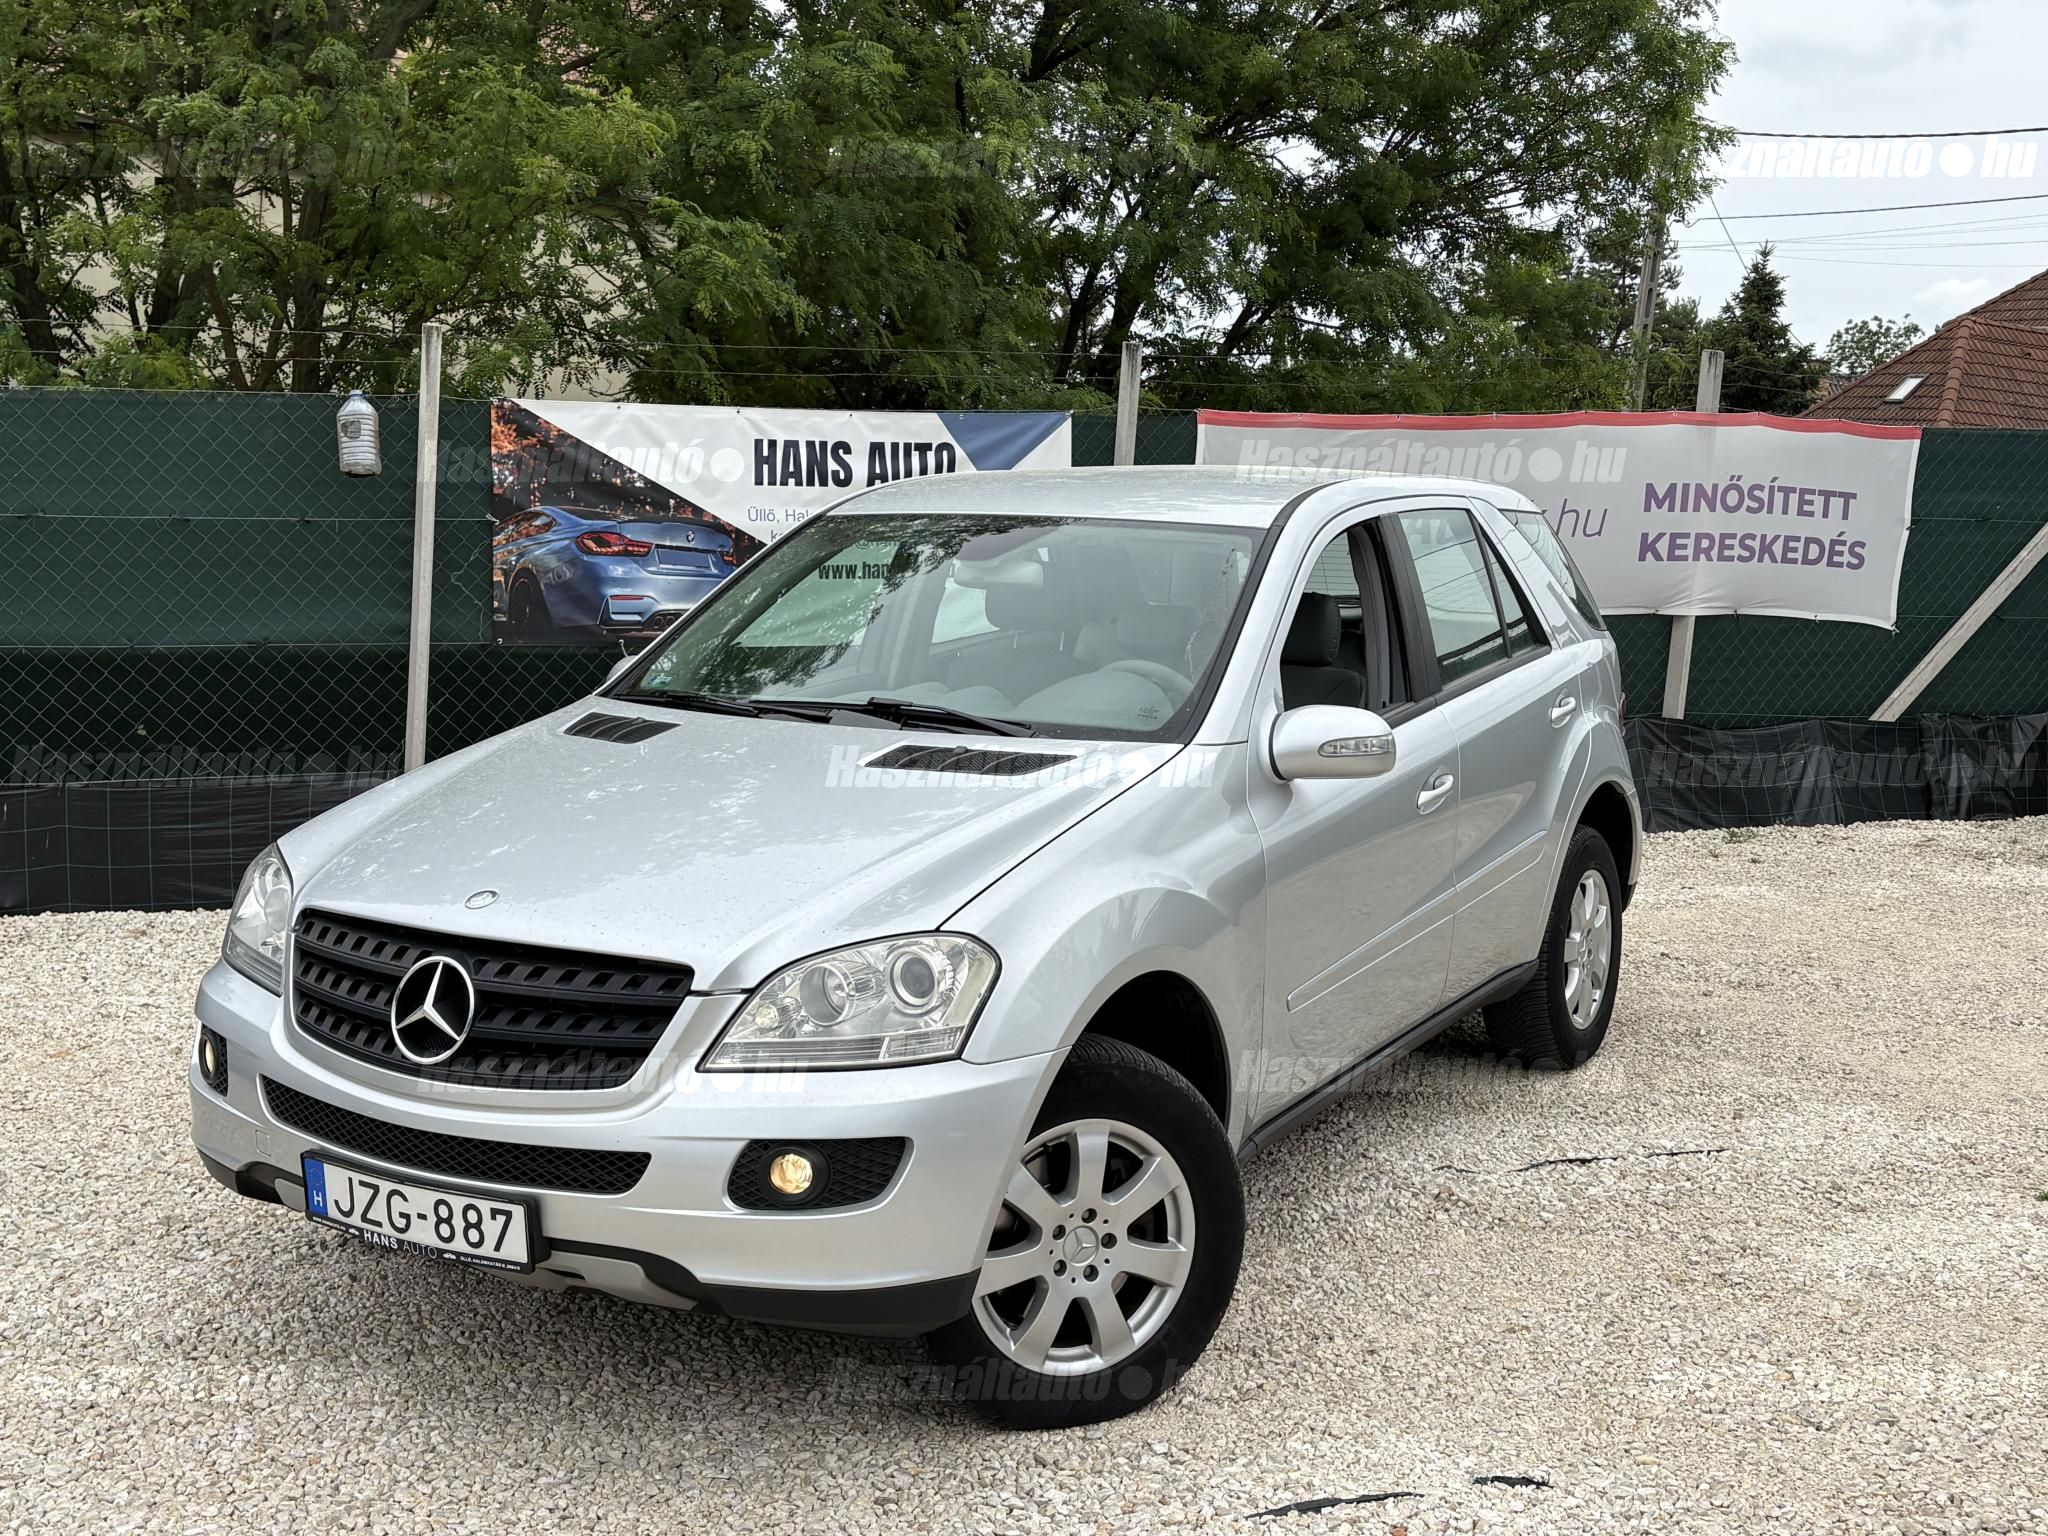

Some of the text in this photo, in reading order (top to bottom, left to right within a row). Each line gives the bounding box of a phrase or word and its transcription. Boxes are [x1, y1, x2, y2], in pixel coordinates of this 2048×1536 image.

[754, 439, 957, 488] HANS AUTO
[747, 506, 780, 524] Üllő,
[1643, 474, 1857, 521] MINŐSÍTETT
[1638, 531, 1866, 570] KERESKEDÉS
[313, 1190, 323, 1208] H
[333, 1176, 513, 1252] JZG-887
[363, 1229, 438, 1259] HANS AUTO
